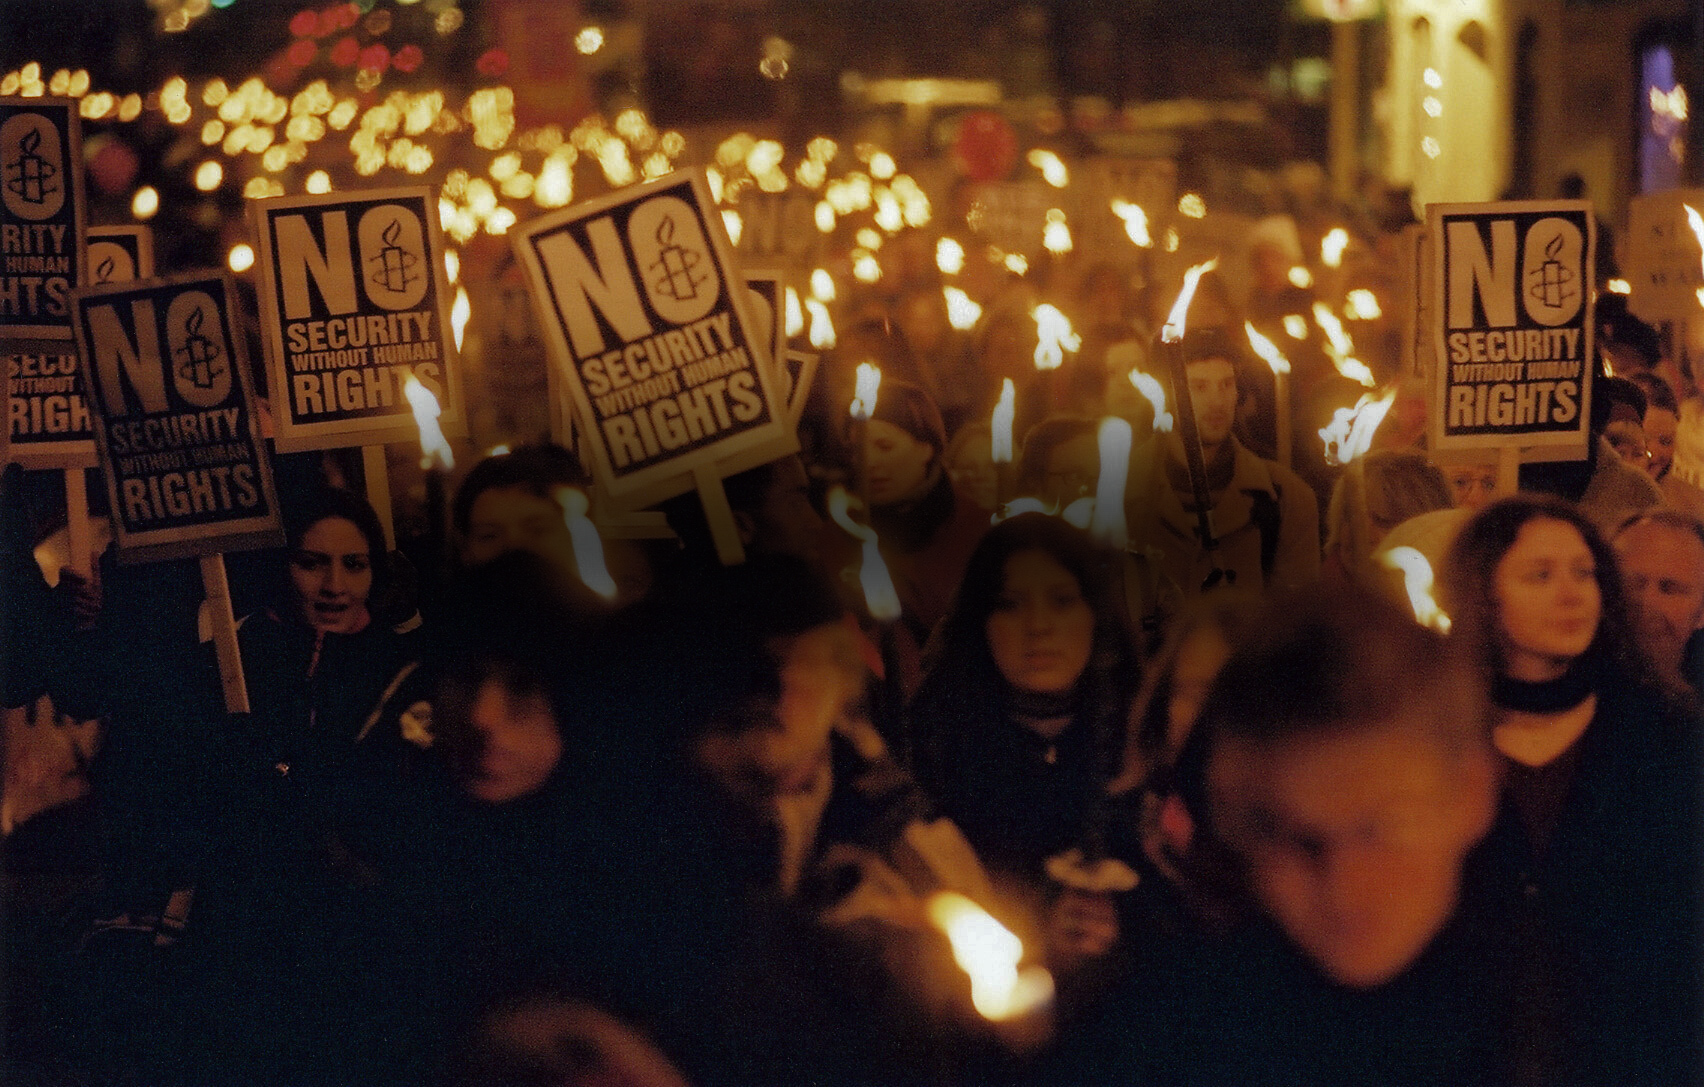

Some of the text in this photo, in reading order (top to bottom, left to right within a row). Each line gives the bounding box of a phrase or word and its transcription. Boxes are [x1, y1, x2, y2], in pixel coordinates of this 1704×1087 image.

[6, 256, 70, 273] HUMAN
[274, 204, 429, 320] NO
[536, 196, 721, 360] NO
[1447, 217, 1585, 329] NO
[87, 290, 233, 416] NO
[287, 311, 432, 353] SECURITY
[292, 341, 438, 372] WITHOUT HUMAN
[581, 312, 734, 397] SECURITY
[1450, 328, 1580, 363] SECURITY
[593, 346, 750, 418] WITHOUT HUMAN
[1453, 360, 1581, 383] WITHOUT HUMAN
[111, 407, 240, 451] SECURITY
[602, 370, 763, 469] RIGHTS
[1449, 381, 1578, 427] RIGHTS
[119, 451, 187, 475] WITHOUT
[122, 463, 258, 521] RIGHTS
